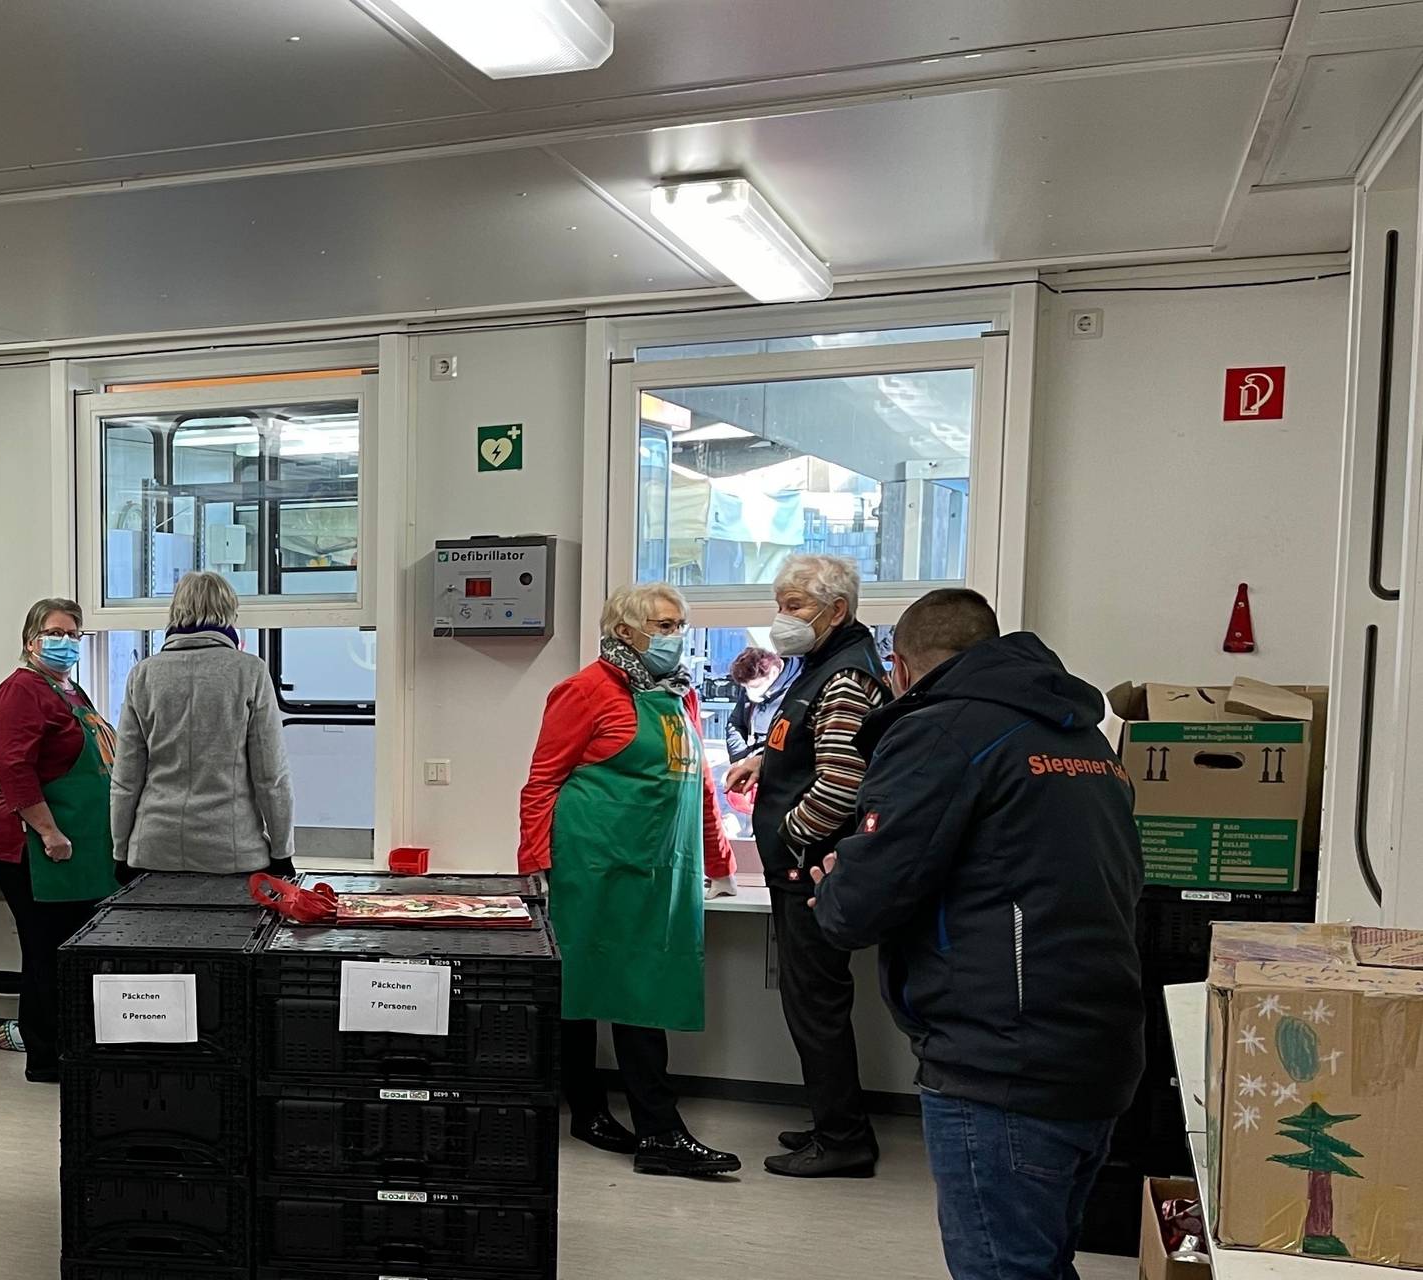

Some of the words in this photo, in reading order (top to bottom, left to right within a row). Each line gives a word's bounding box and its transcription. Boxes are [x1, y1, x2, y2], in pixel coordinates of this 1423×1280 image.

[451, 550, 525, 562] Defibrillator
[1028, 754, 1108, 777] Siegener
[370, 980, 412, 990] Päckchen
[121, 992, 160, 1000] Päckchen
[370, 1001, 376, 1009] 7
[377, 1001, 418, 1011] Personen
[122, 1012, 128, 1020] 6
[129, 1012, 167, 1020] Personen
